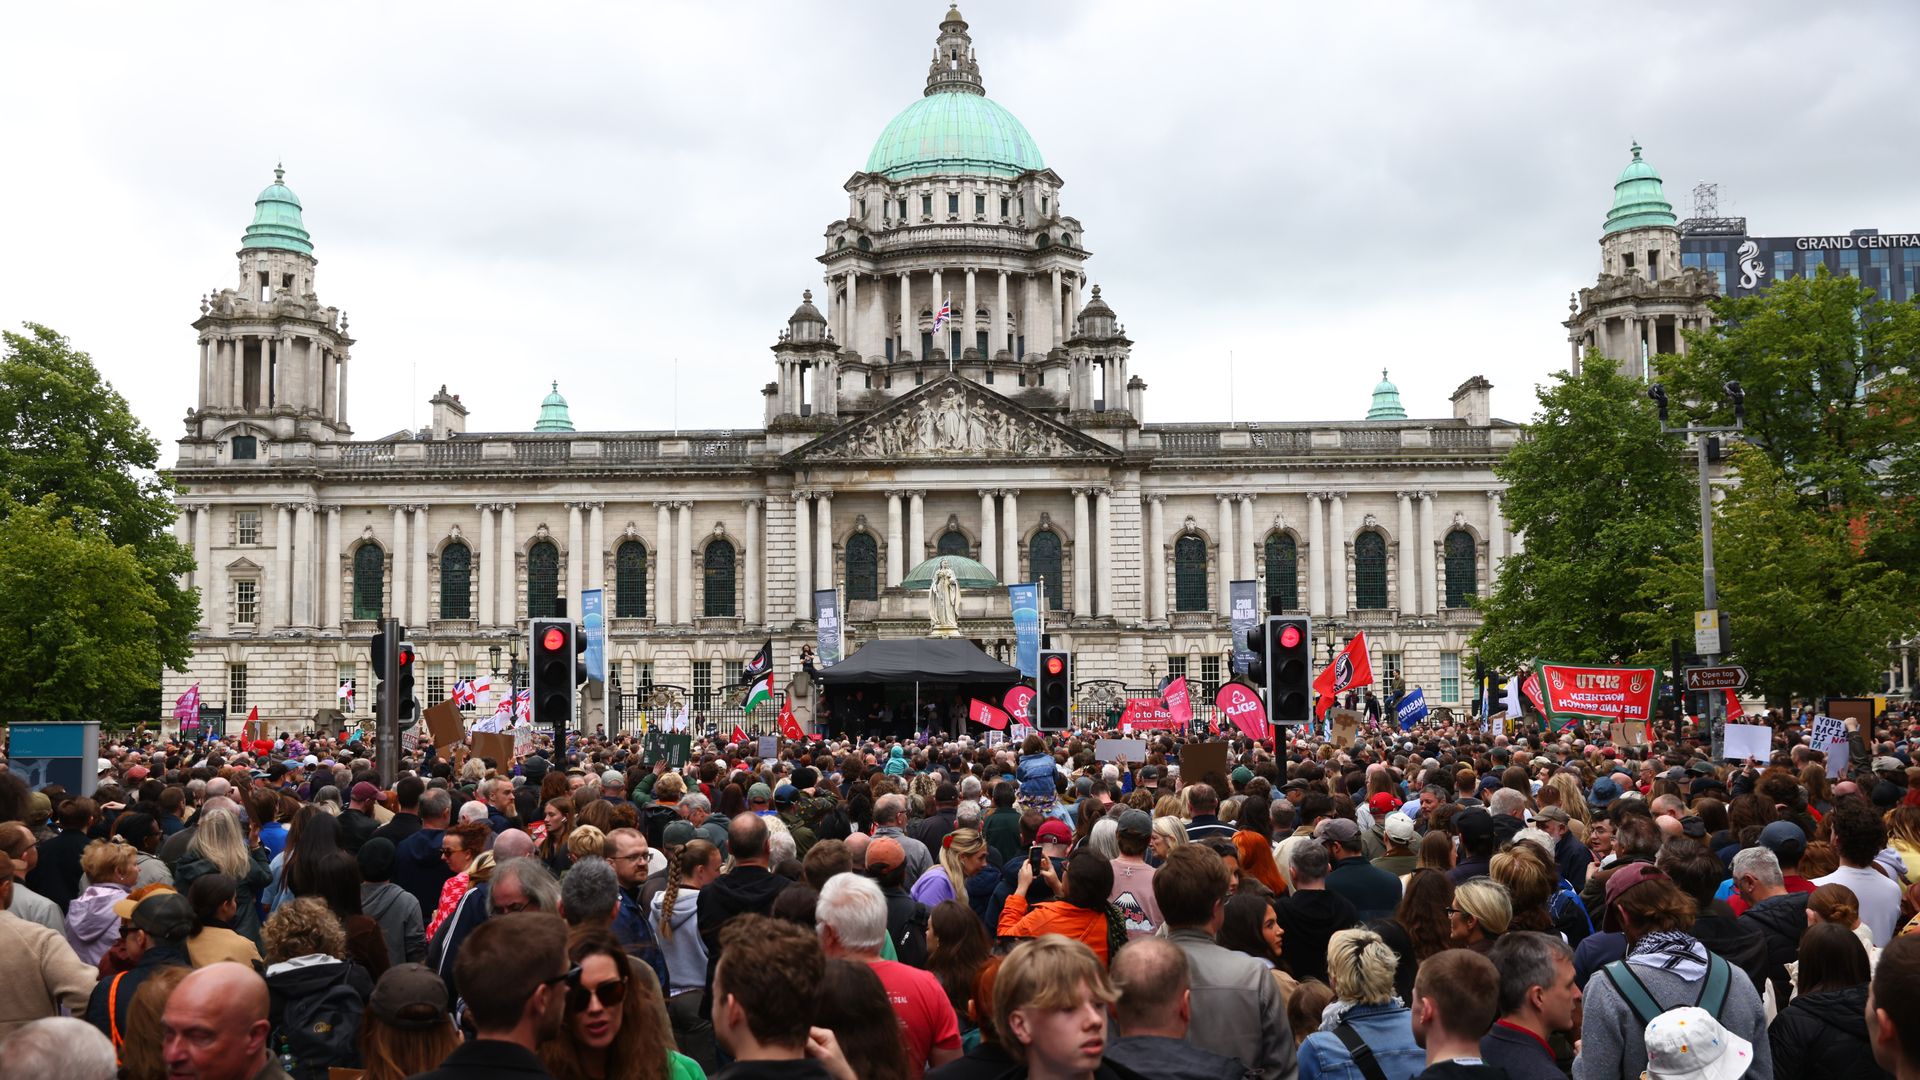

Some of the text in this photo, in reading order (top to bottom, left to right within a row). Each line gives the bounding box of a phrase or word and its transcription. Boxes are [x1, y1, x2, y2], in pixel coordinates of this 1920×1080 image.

[1796, 235, 1920, 250] GRAND CENTRA
[1701, 671, 1720, 679] Open
[1820, 717, 1842, 729] YOUR
[1813, 732, 1828, 742] IS
[1815, 725, 1849, 738] RACIS
